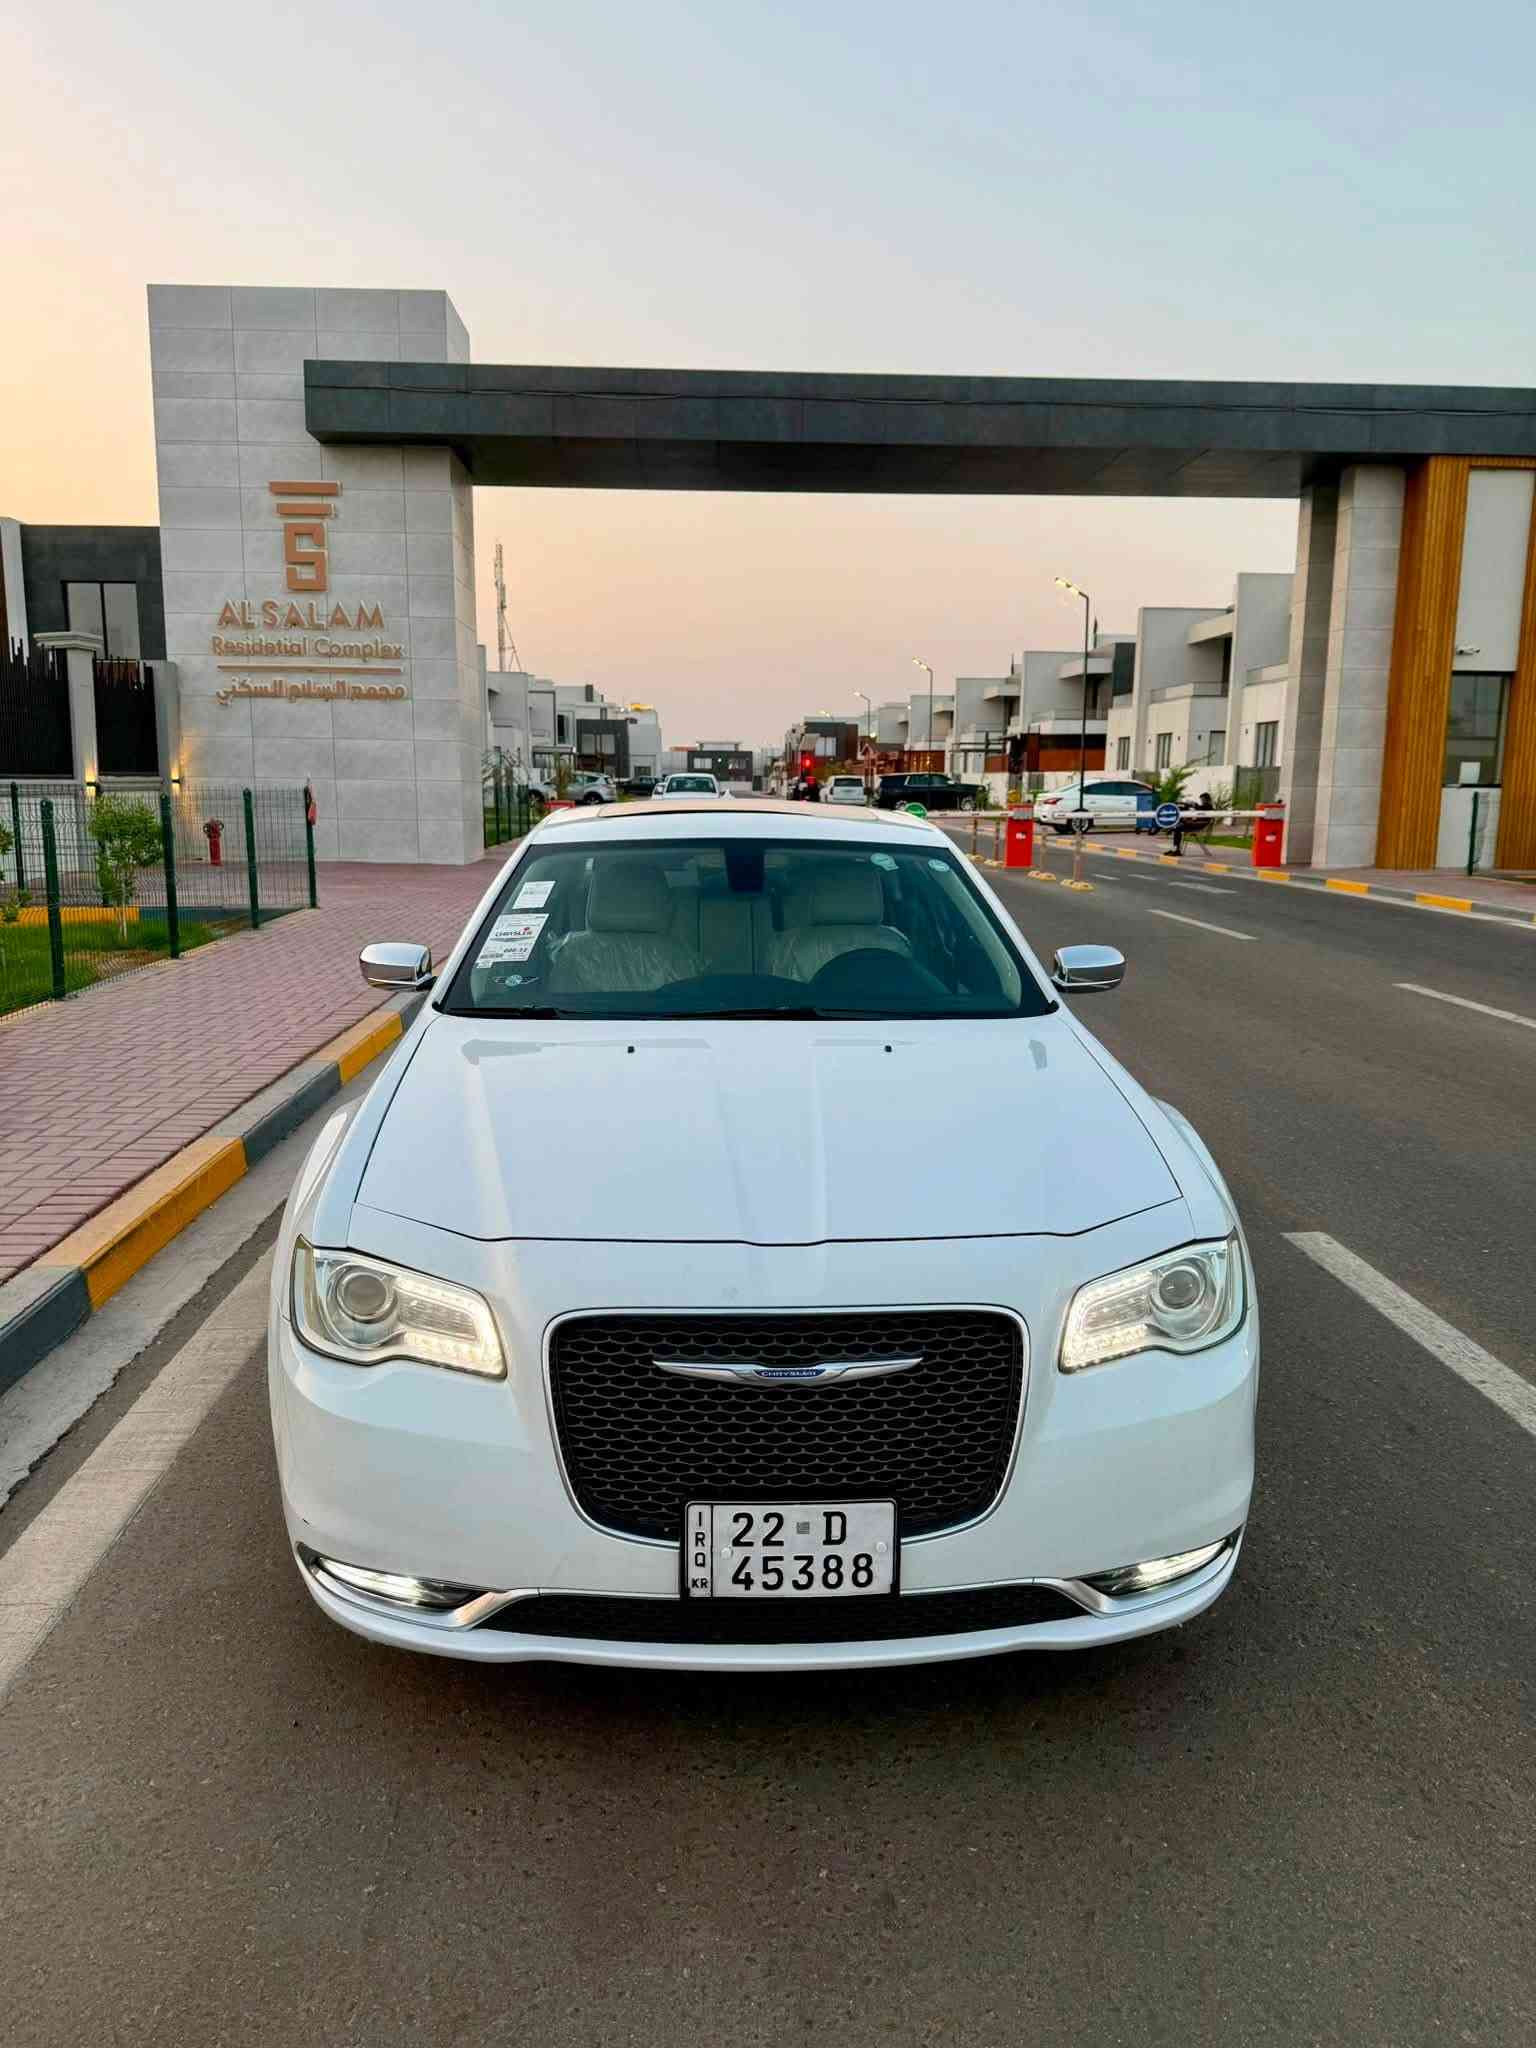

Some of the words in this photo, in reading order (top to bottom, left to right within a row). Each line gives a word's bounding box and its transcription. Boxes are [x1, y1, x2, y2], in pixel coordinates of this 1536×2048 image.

[313, 636, 405, 662] Complex
[215, 676, 286, 704] السكني
[288, 677, 348, 703] السلام
[350, 683, 408, 701] مجمع
[731, 1512, 785, 1547] 22
[822, 1511, 847, 1546] D
[691, 1577, 708, 1589] KR
[731, 1553, 874, 1591] 45388
